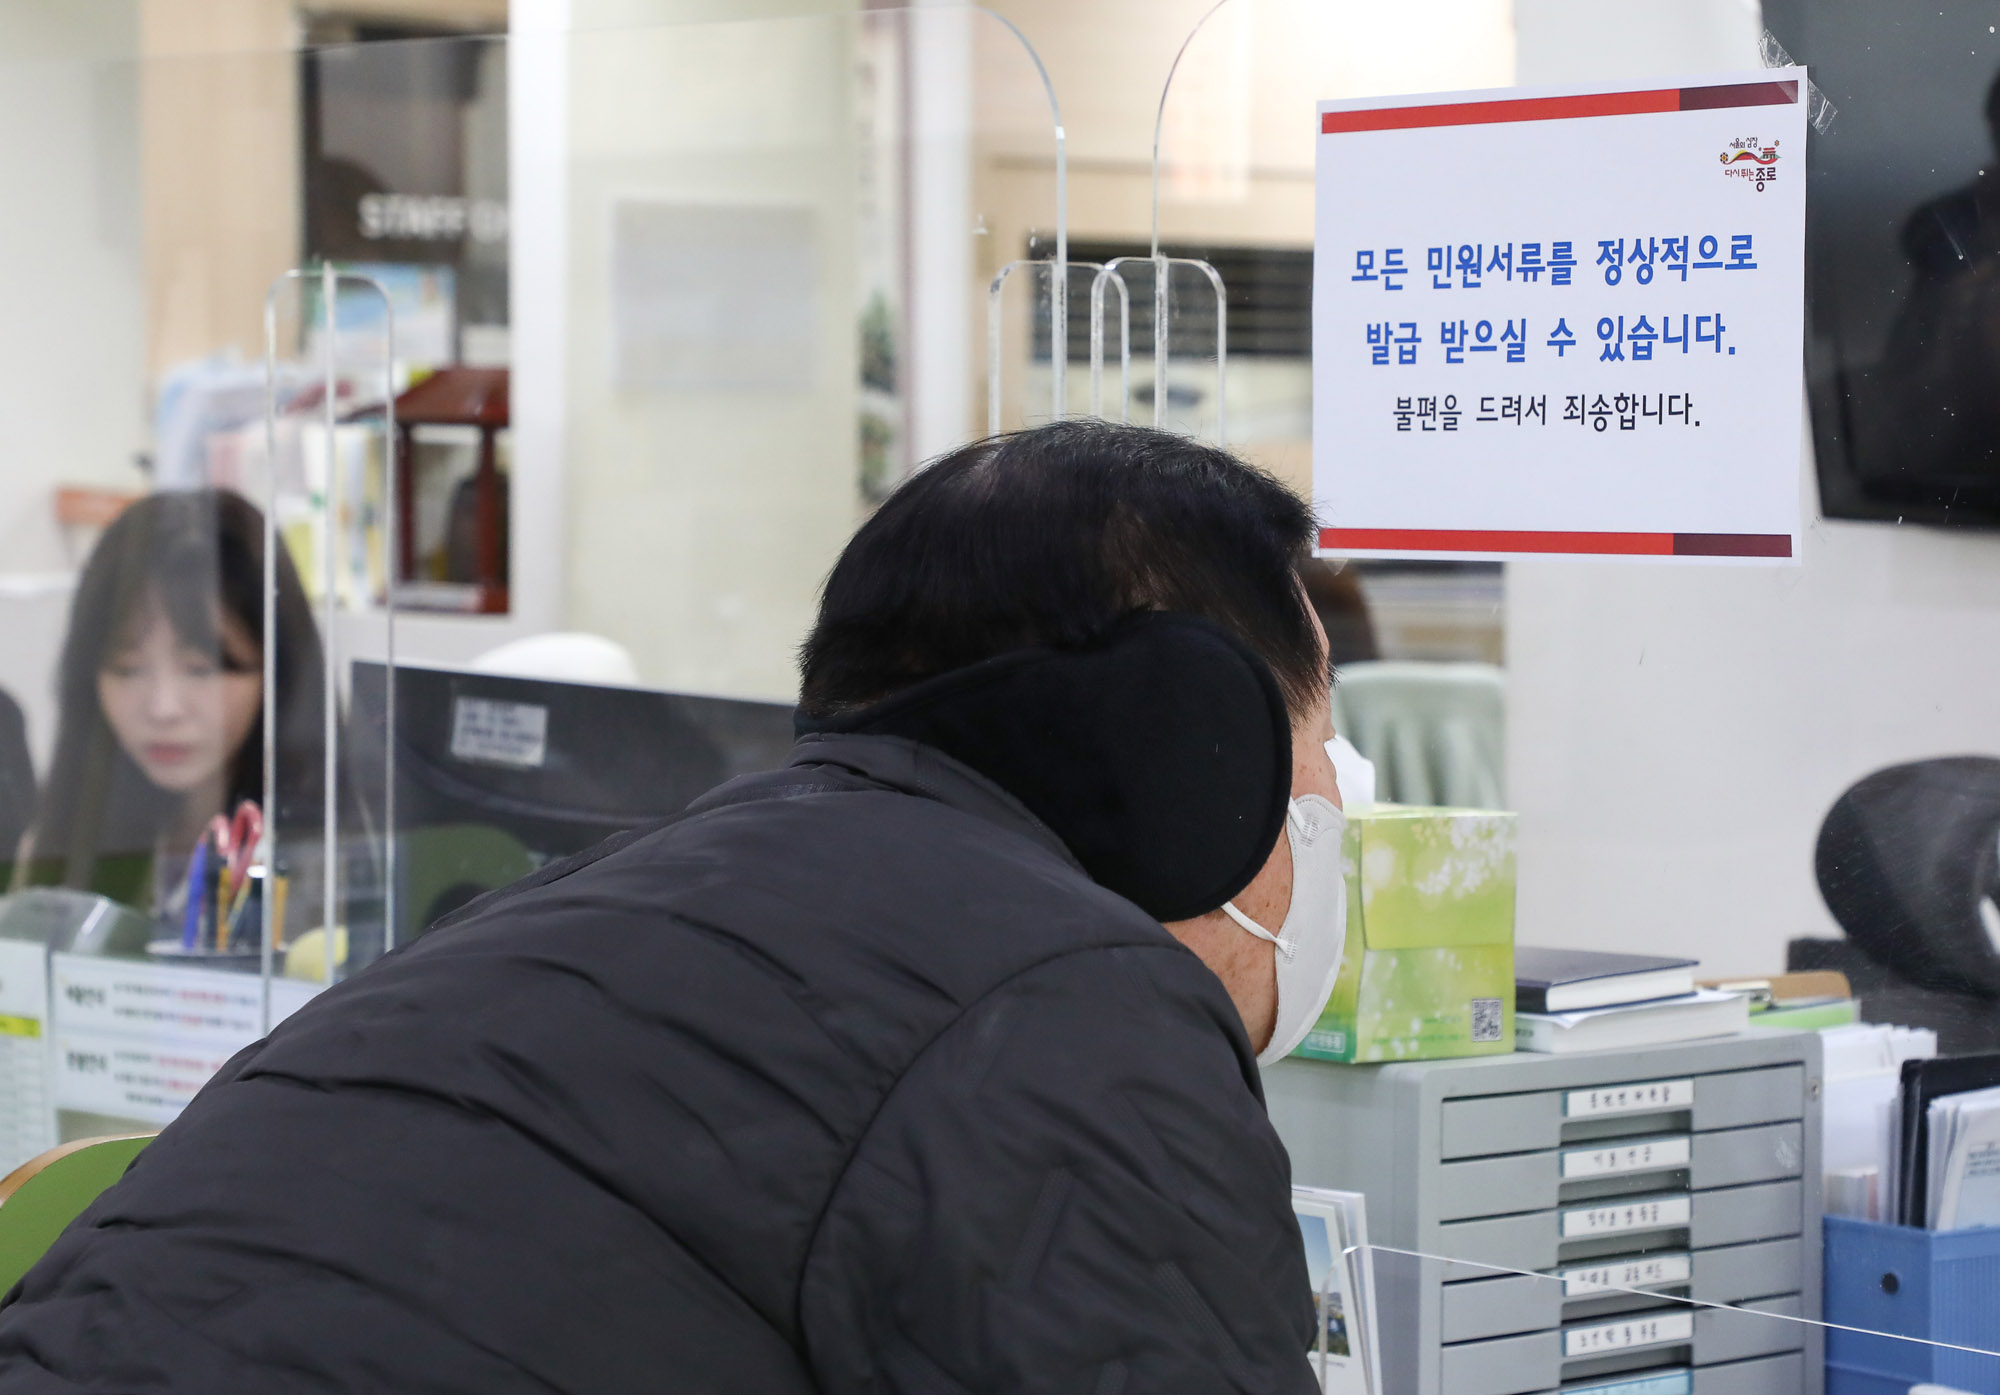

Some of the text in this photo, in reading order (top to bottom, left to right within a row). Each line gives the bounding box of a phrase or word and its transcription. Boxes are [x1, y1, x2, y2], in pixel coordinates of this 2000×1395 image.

[1729, 137, 1758, 149] 서울의 심장
[1725, 166, 1777, 193] 다시 뛰는 종로
[1351, 234, 1758, 291] 모든 민원서류를 정상적으로
[1366, 312, 1736, 366] 발급 받으실 수 있습니다.
[1392, 392, 1701, 433] 불편을 드려서 죄송합니다.
